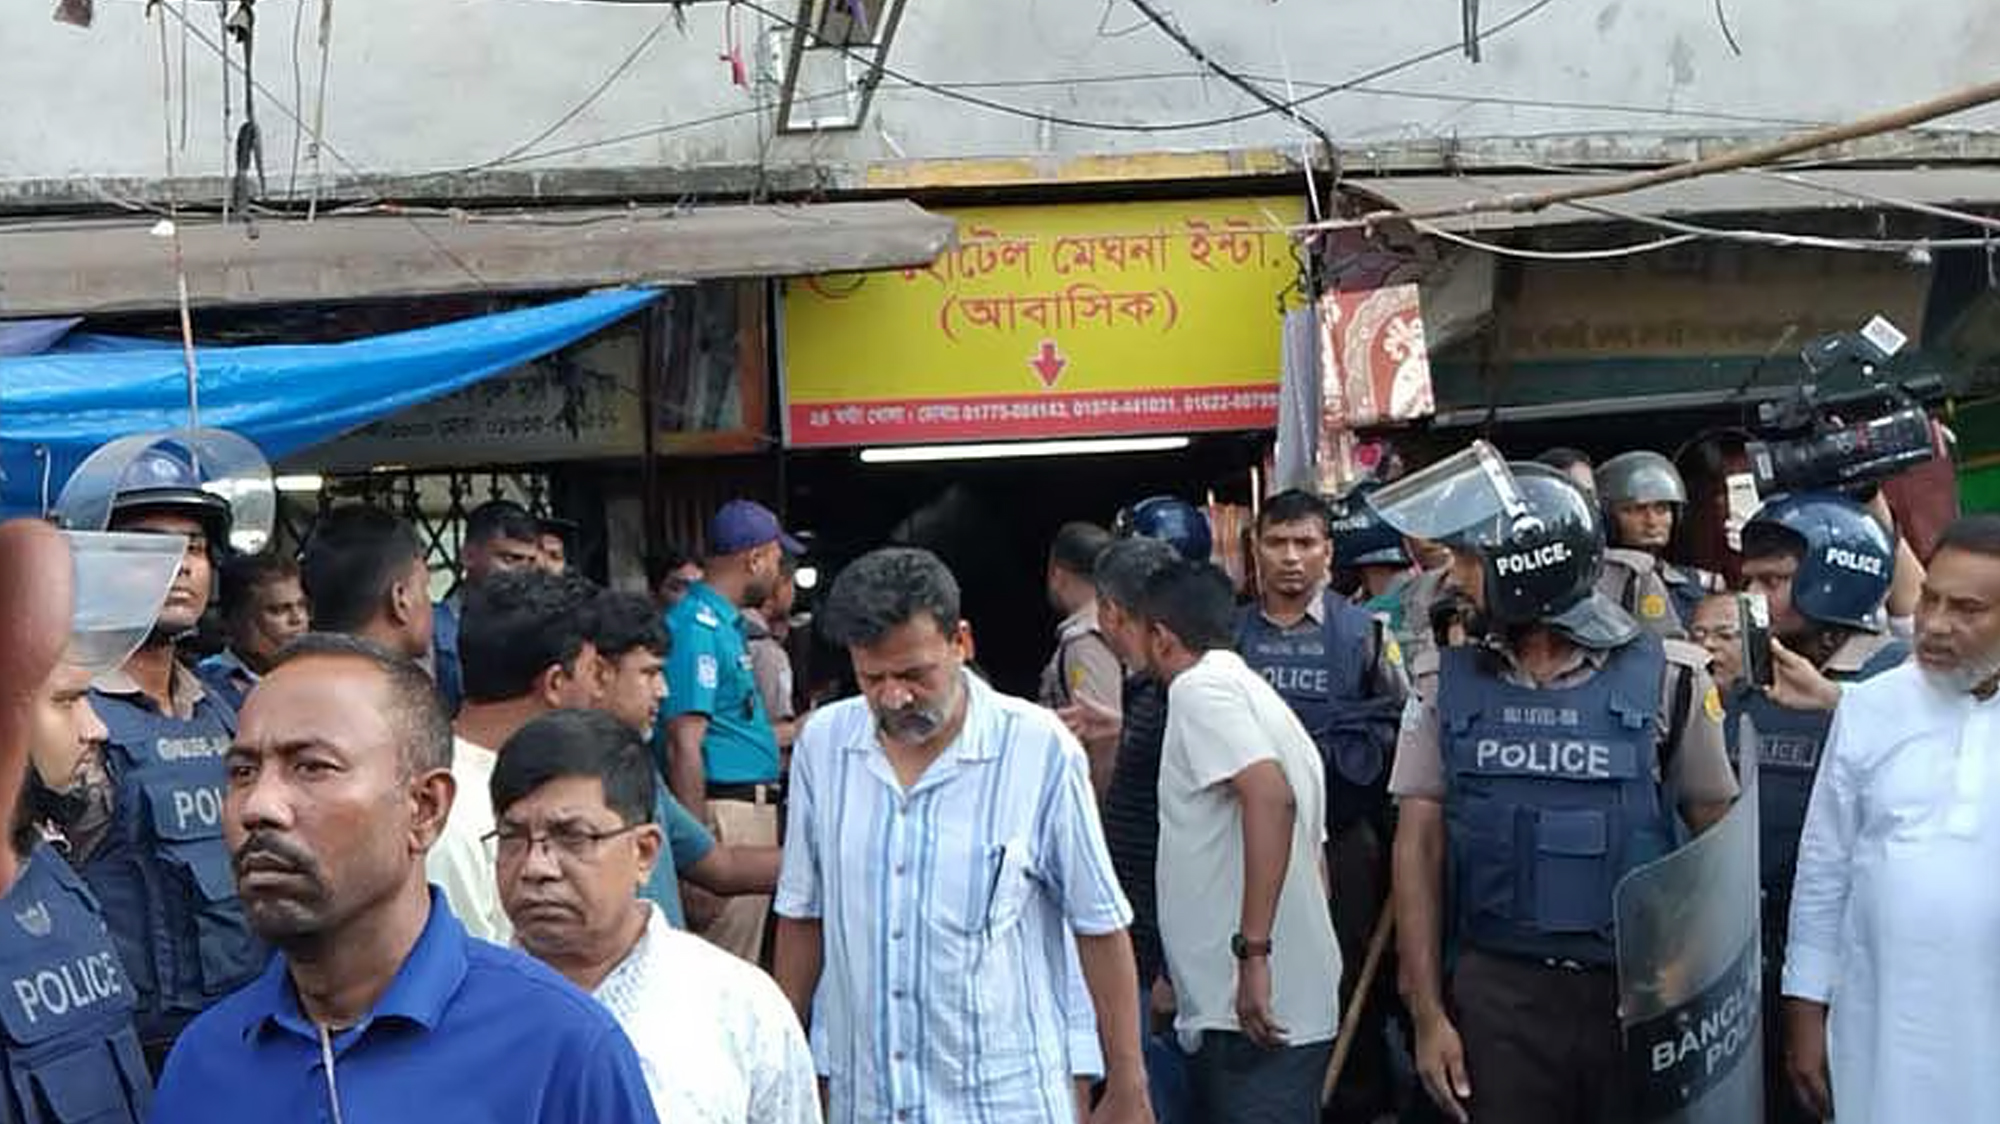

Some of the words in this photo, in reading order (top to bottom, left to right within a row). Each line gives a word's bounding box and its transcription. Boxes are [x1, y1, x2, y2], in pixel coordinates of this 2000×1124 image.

[1052, 230, 1172, 274] মেঘনা
[939, 282, 1180, 342] (আবাসিক)
[1826, 548, 1881, 575] POLICE
[1477, 738, 1610, 778] POLICE
[12, 952, 121, 1022] POLICE
